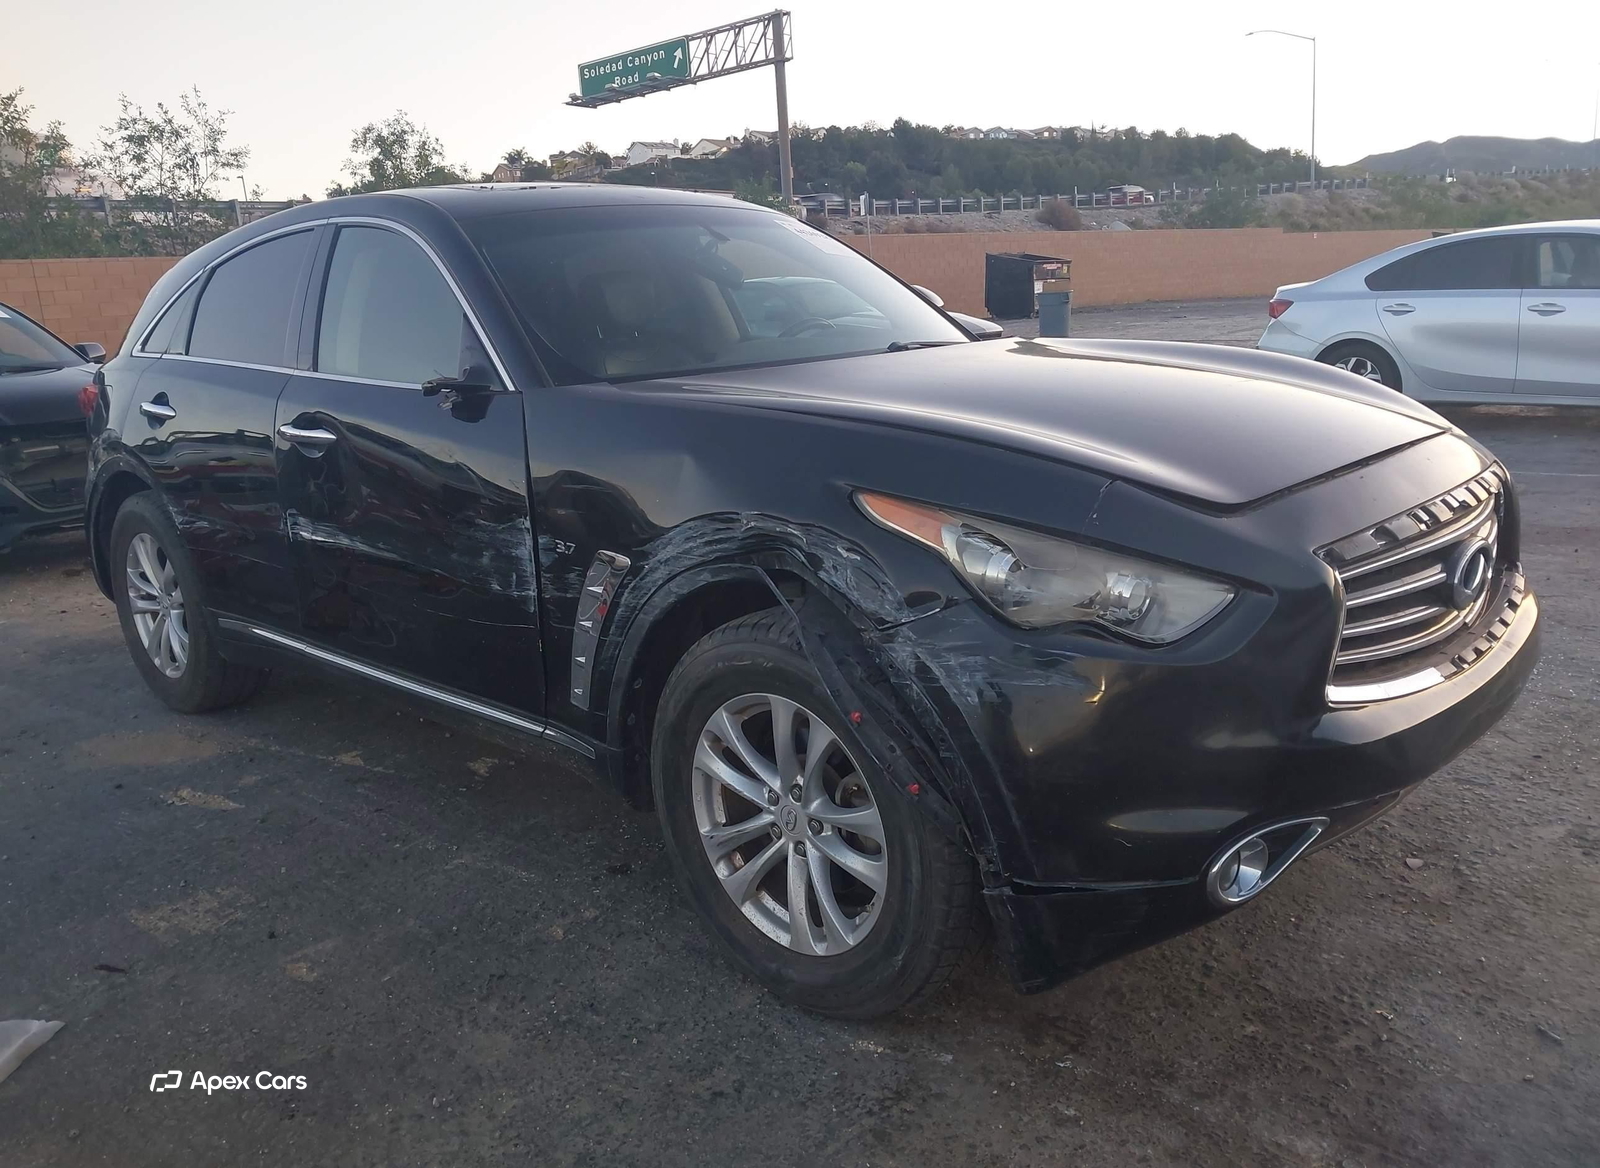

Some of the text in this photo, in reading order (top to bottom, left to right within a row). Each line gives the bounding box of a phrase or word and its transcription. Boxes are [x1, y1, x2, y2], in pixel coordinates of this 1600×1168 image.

[583, 49, 665, 79] Soledad Canyon
[614, 72, 639, 87] Road
